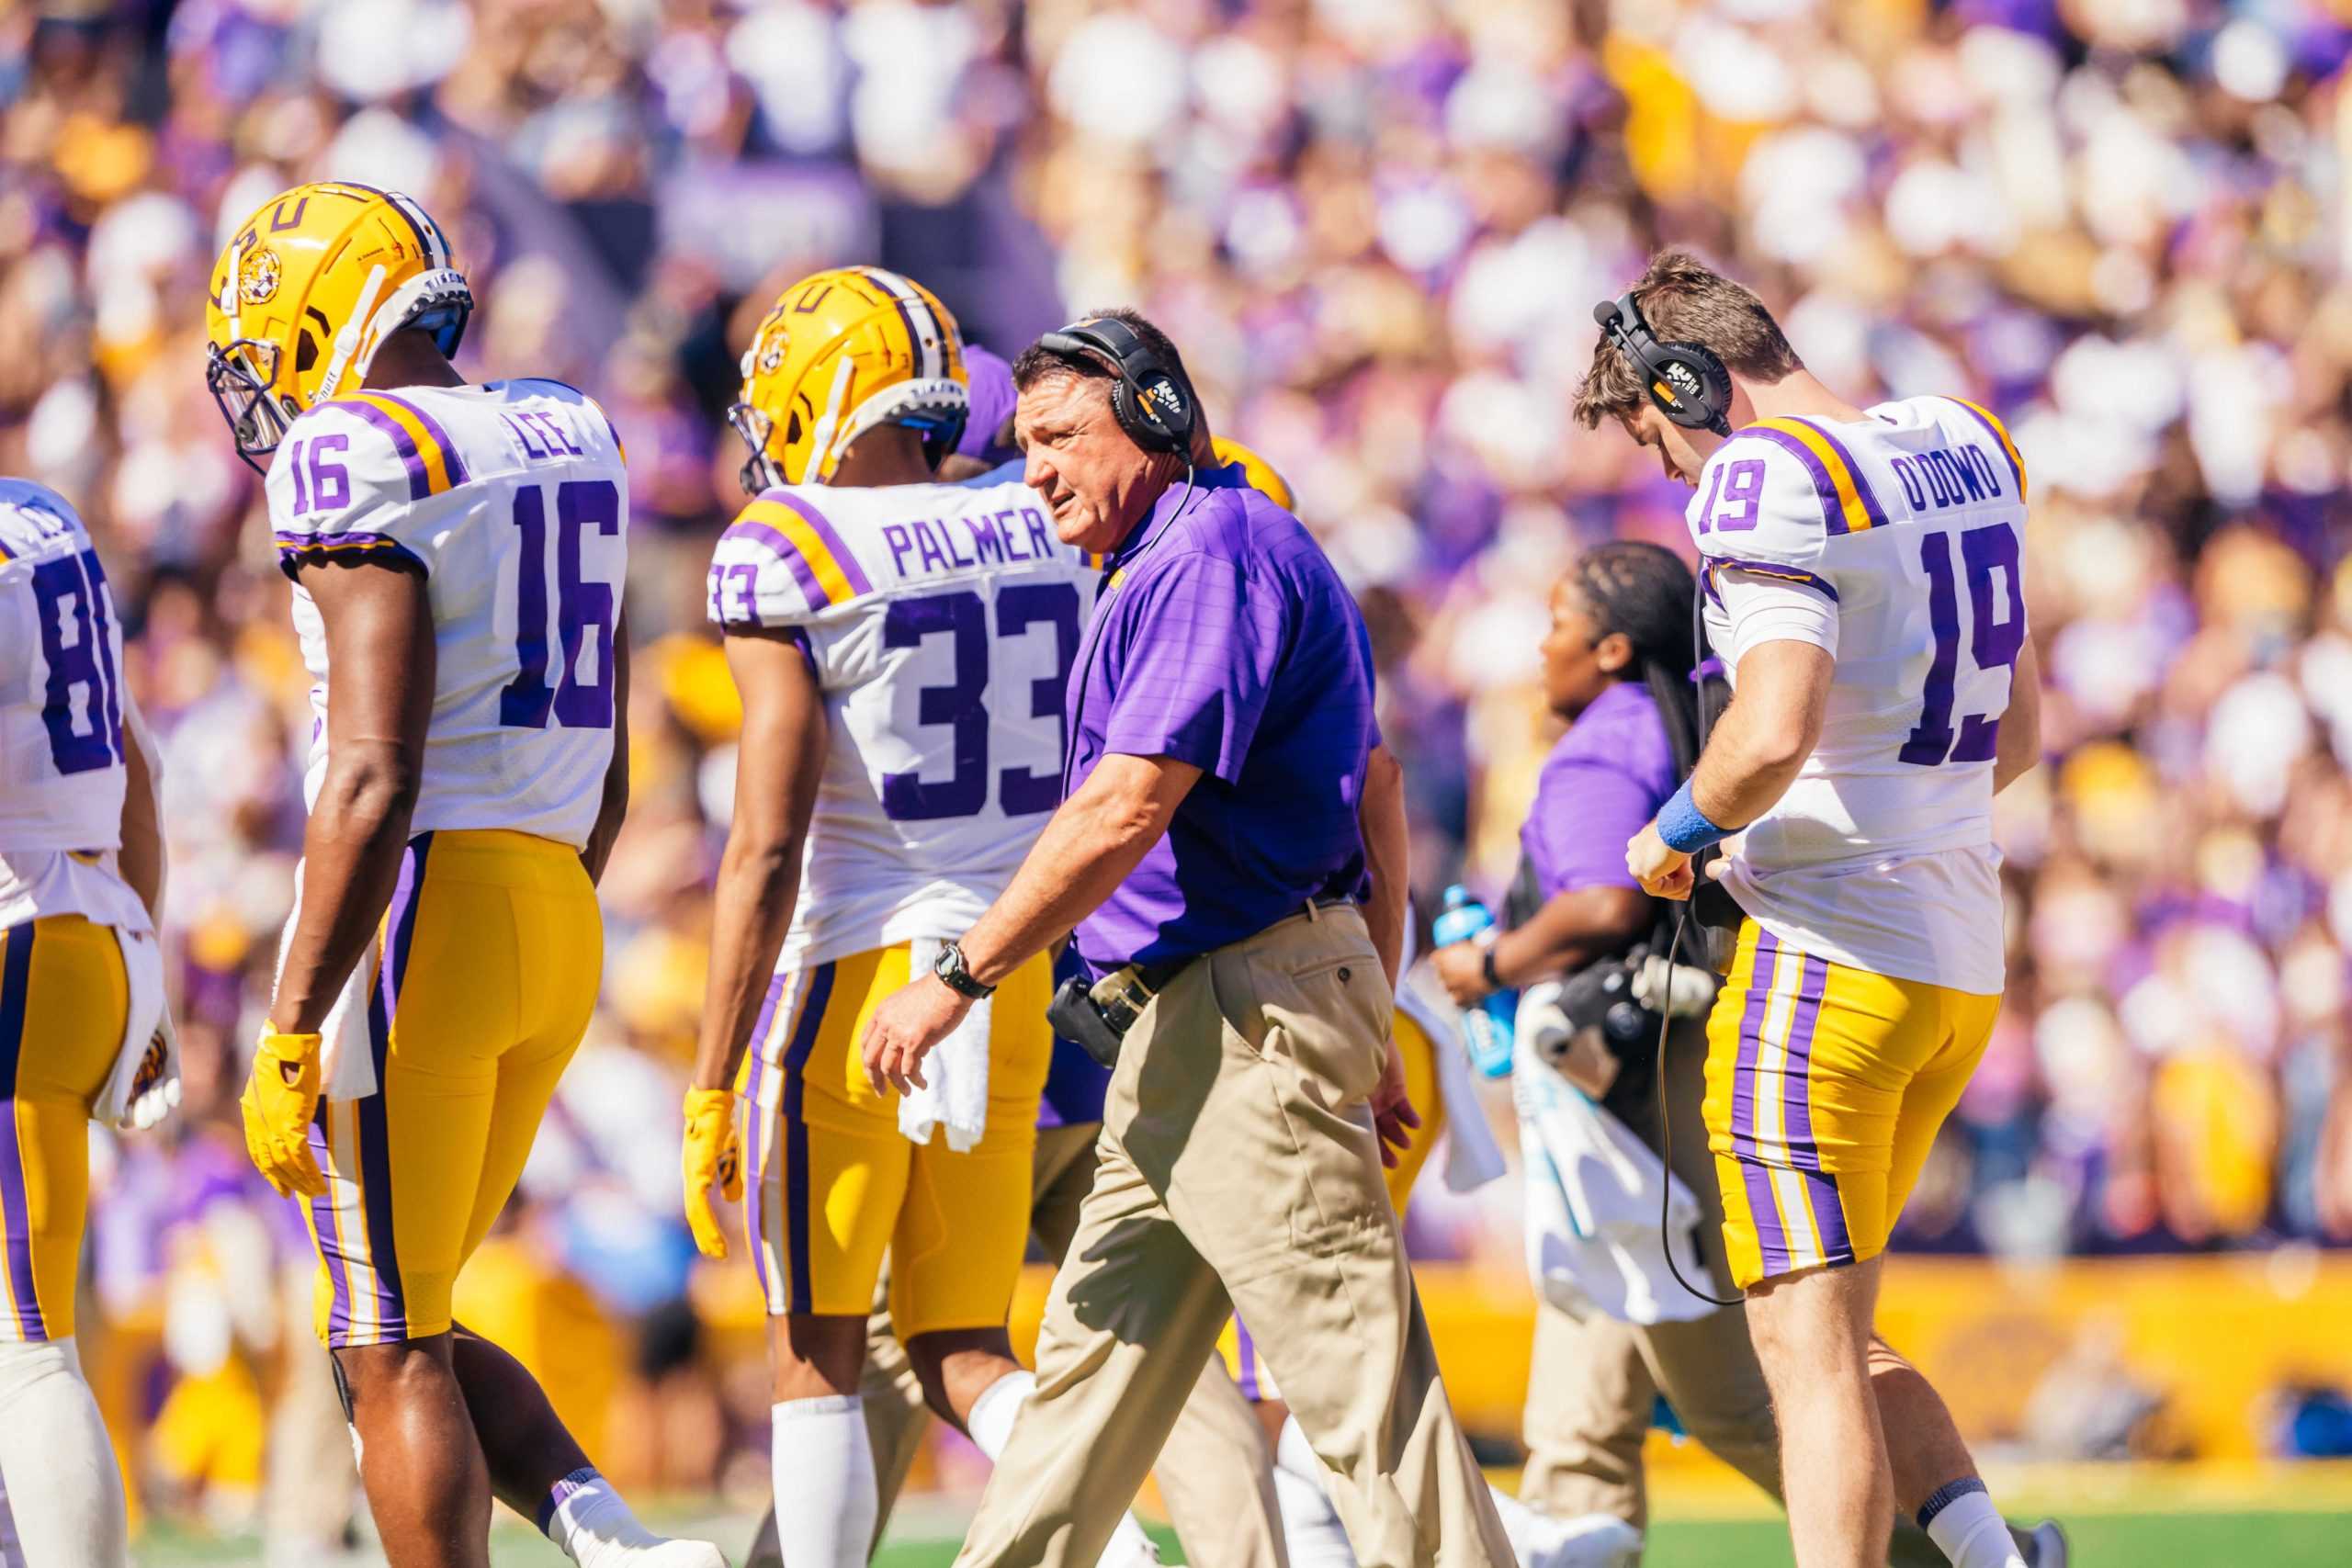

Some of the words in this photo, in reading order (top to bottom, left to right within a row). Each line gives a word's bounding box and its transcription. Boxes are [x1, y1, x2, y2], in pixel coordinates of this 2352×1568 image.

[289, 434, 351, 516] 16
[500, 412, 582, 459] LEE
[1700, 458, 1766, 535] 19
[882, 507, 1053, 577] PALMER
[499, 479, 619, 729] 16
[1897, 521, 2027, 766] 19
[883, 581, 1080, 821] 33
